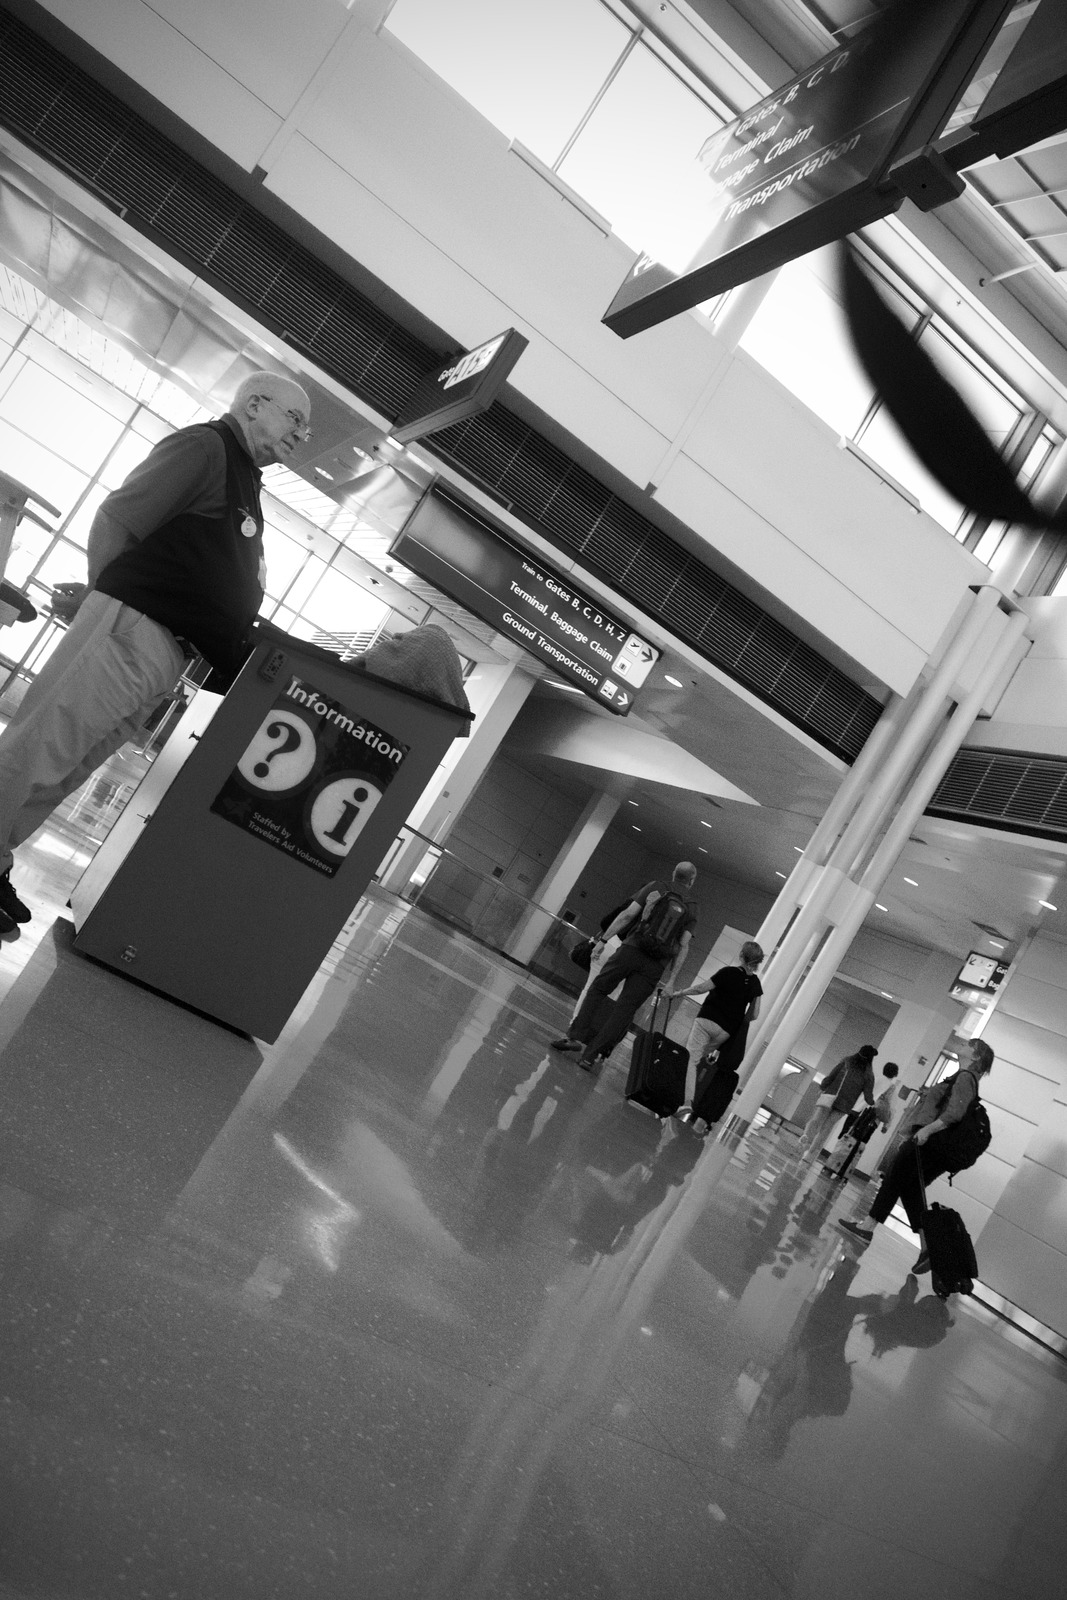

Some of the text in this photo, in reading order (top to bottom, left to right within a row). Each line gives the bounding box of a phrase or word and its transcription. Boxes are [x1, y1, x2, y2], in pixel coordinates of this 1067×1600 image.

[714, 115, 785, 174] Terminal
[735, 99, 781, 136] Gates
[764, 124, 814, 165] Claim
[724, 133, 861, 222] Transportation
[509, 580, 614, 663] Terminal, Baggage Claim
[521, 561, 626, 642] Train to Gates B, C, D, H, Z
[502, 612, 600, 686] Ground Transportation
[286, 680, 403, 763] Information
[248, 820, 334, 874] Travelers Aid Volunteers
[252, 811, 292, 839] Staffed by
